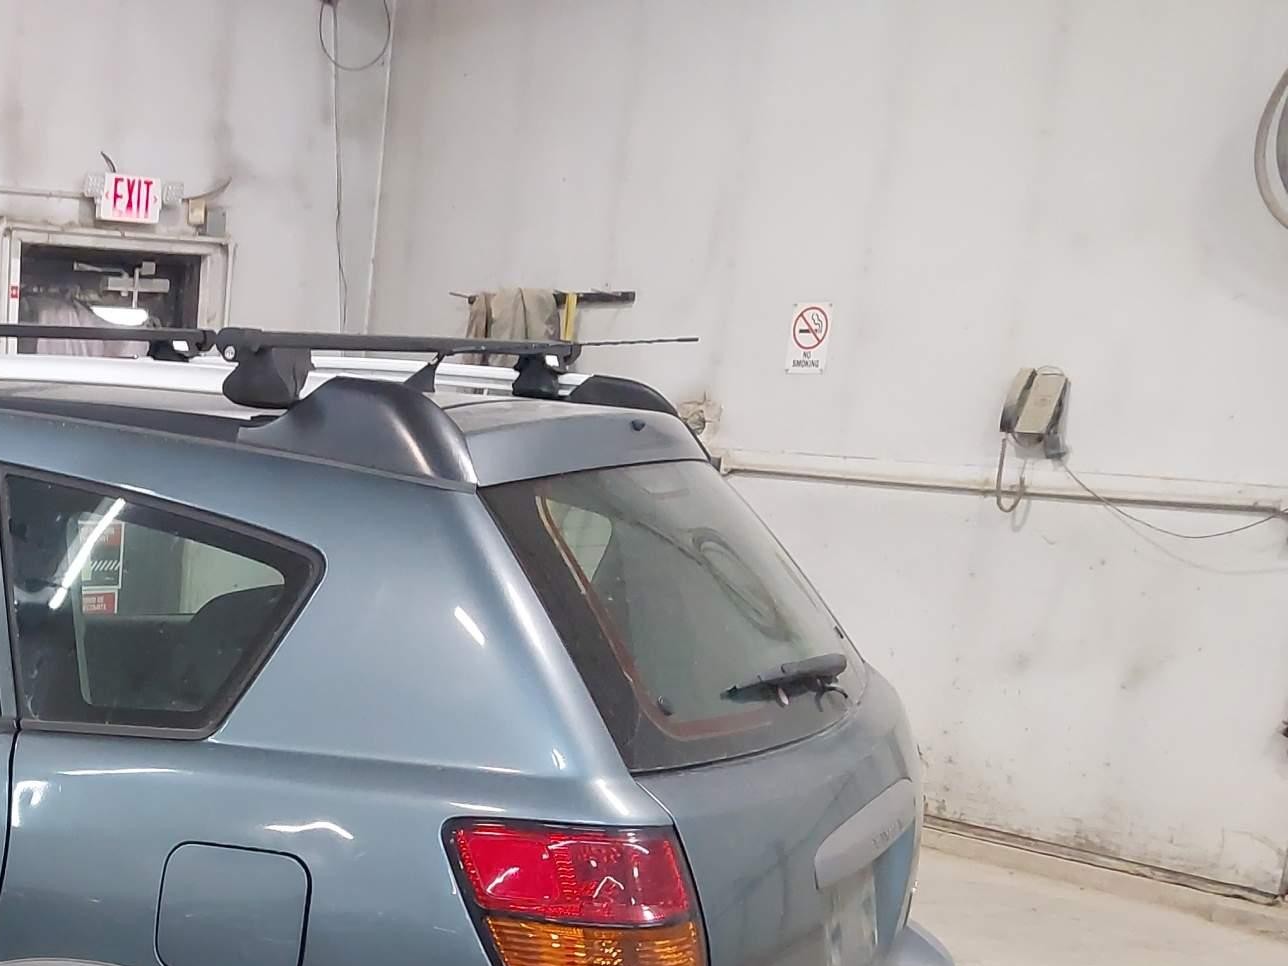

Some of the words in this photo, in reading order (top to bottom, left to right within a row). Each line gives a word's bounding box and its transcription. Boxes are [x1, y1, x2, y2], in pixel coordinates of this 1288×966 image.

[113, 177, 153, 219] EXIT
[802, 351, 812, 360] NO
[791, 359, 820, 368] SMOKING
